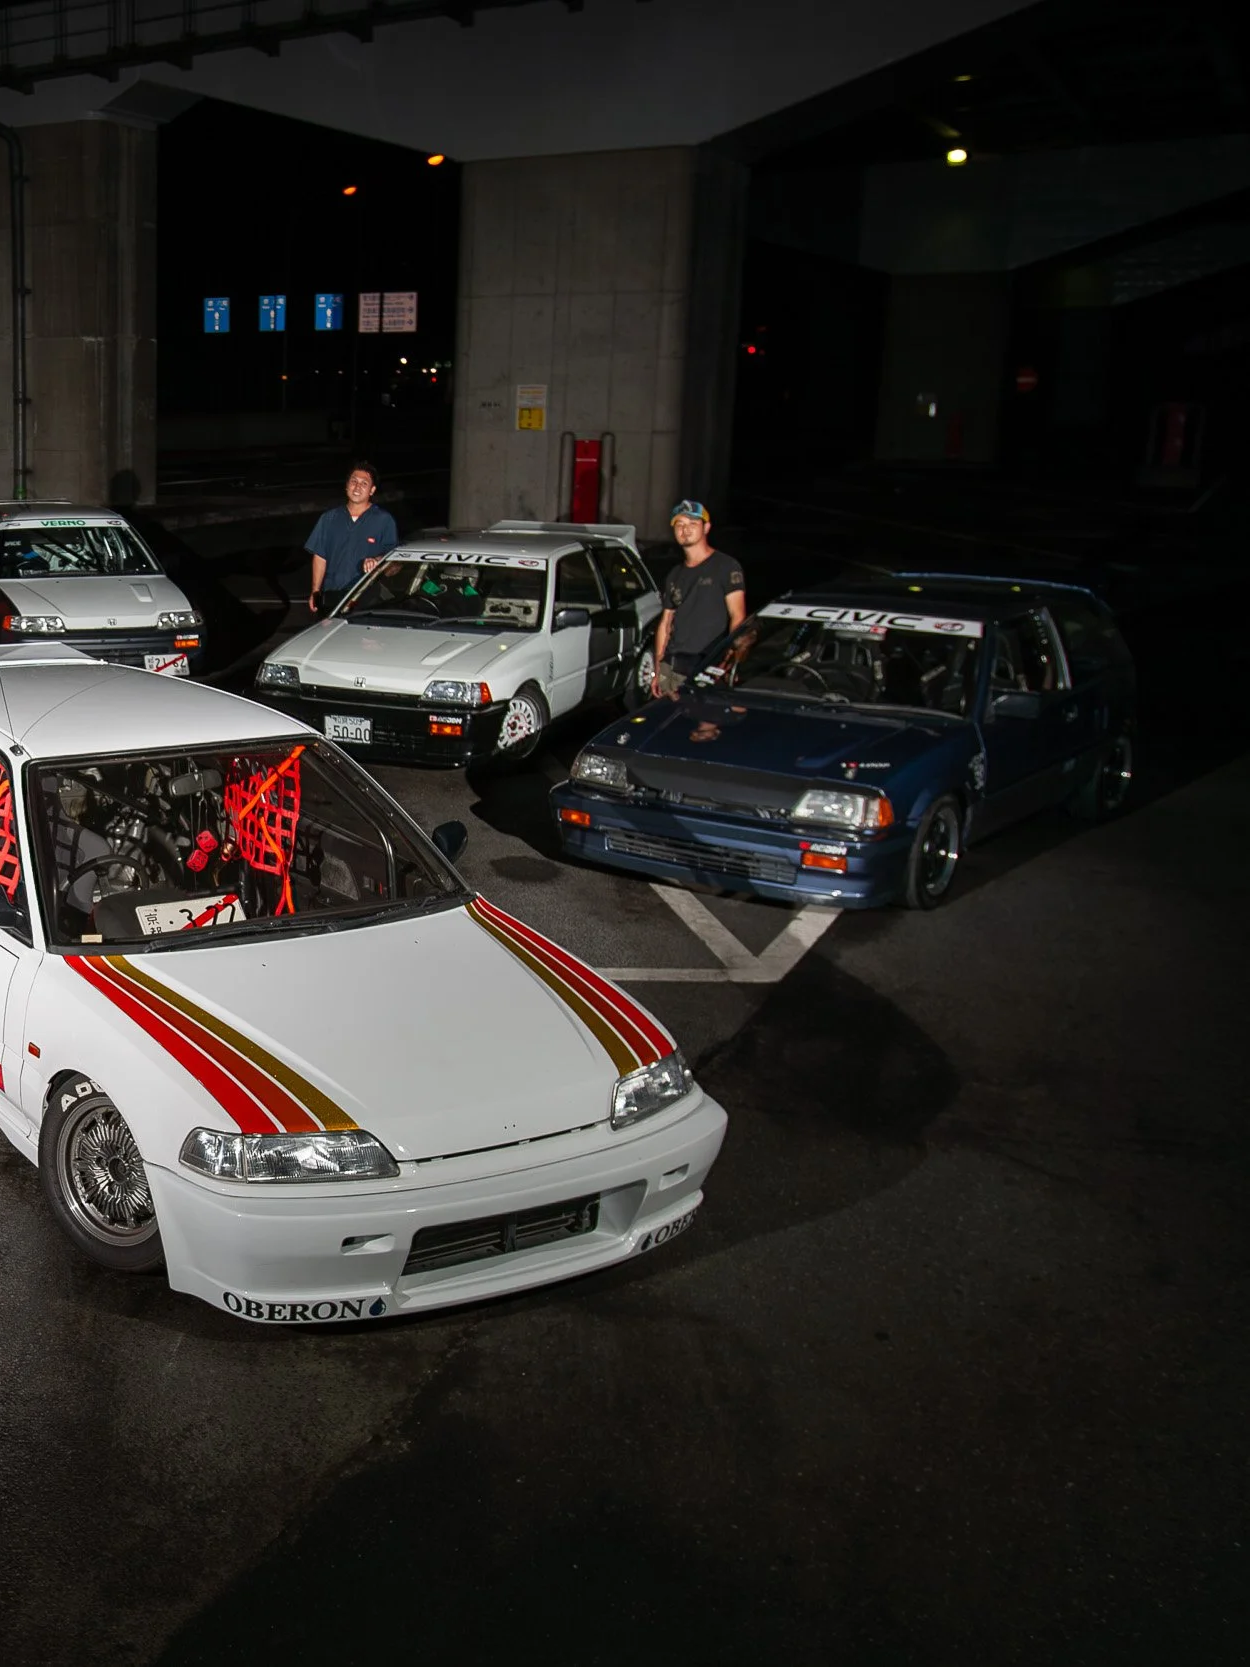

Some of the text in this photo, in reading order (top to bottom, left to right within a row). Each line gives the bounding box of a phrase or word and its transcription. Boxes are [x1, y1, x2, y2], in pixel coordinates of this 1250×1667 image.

[420, 553, 509, 565] CIVIC
[806, 608, 922, 628] CIVIC
[223, 1292, 366, 1321] OBERON
